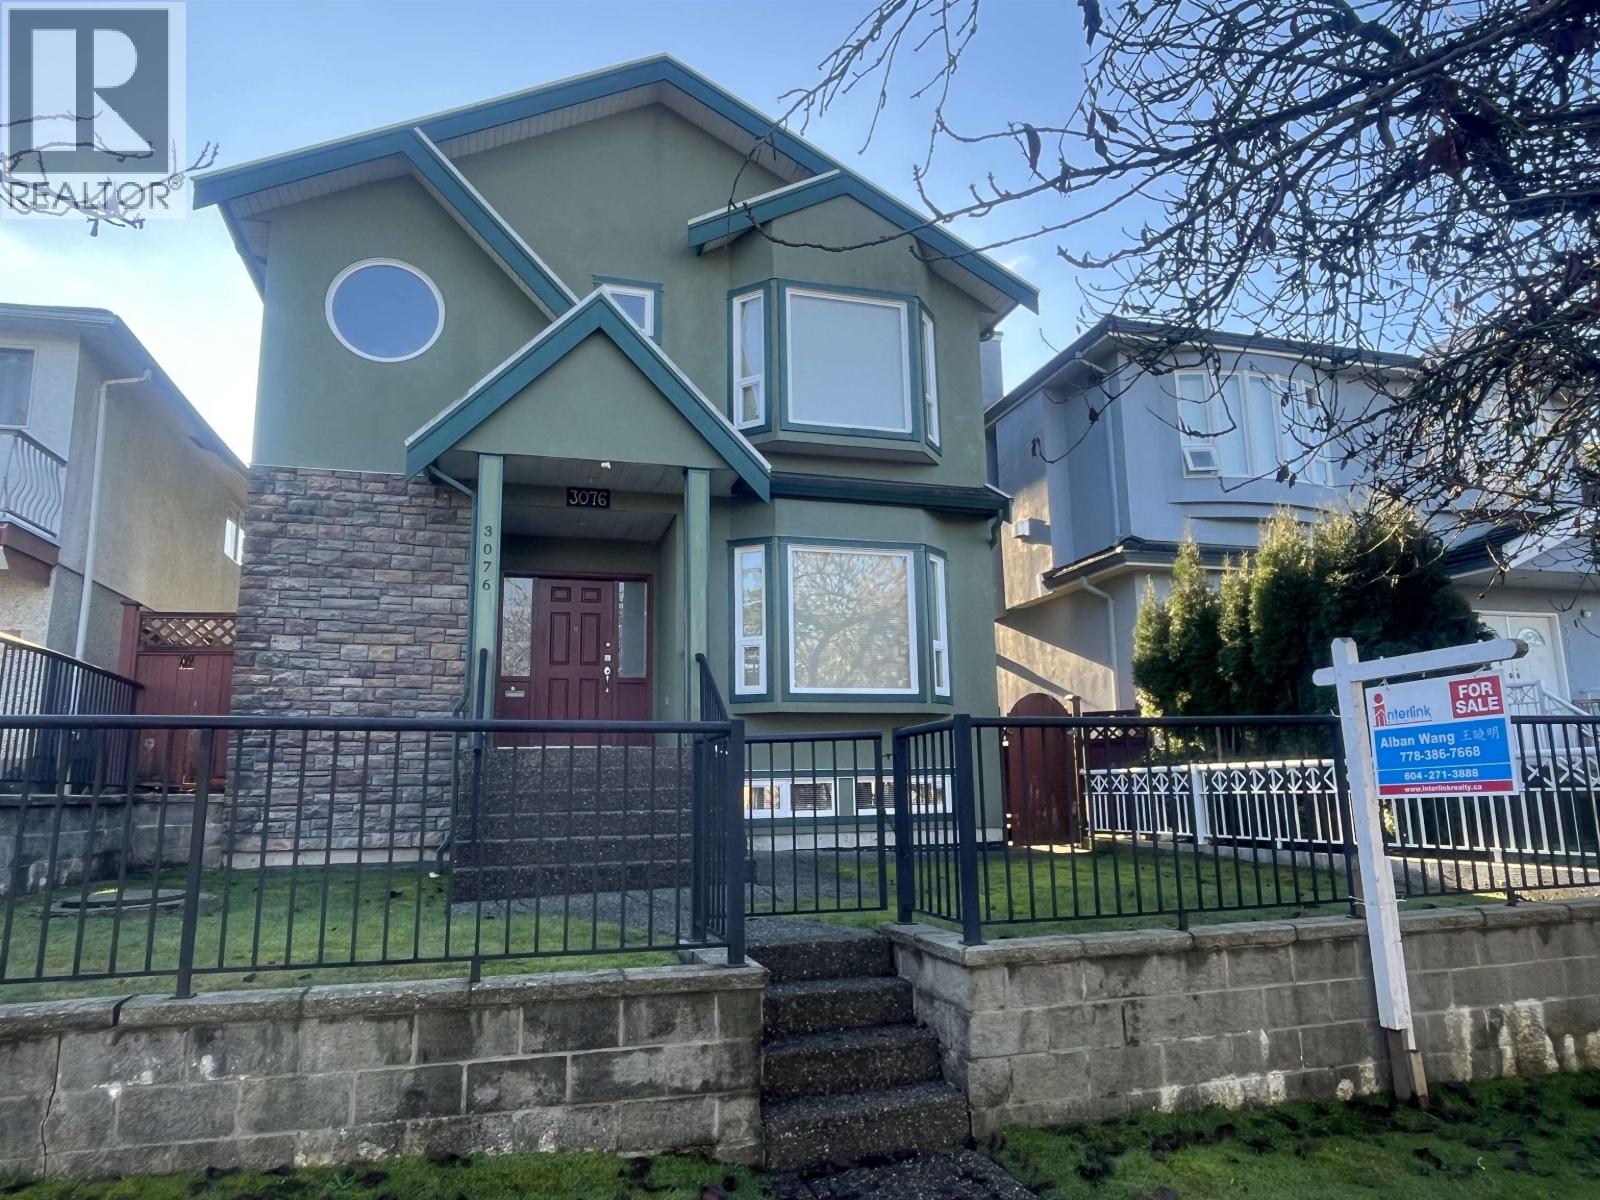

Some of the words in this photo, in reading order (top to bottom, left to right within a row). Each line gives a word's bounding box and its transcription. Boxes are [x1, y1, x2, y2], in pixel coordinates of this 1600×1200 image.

[569, 489, 607, 506] 3076
[482, 525, 493, 591] 3076
[1458, 681, 1493, 699] FOR
[1456, 696, 1500, 714] SALE
[1380, 735, 1415, 749] Alban
[1418, 732, 1456, 746] Wang
[1400, 746, 1481, 763] 778-386-7668
